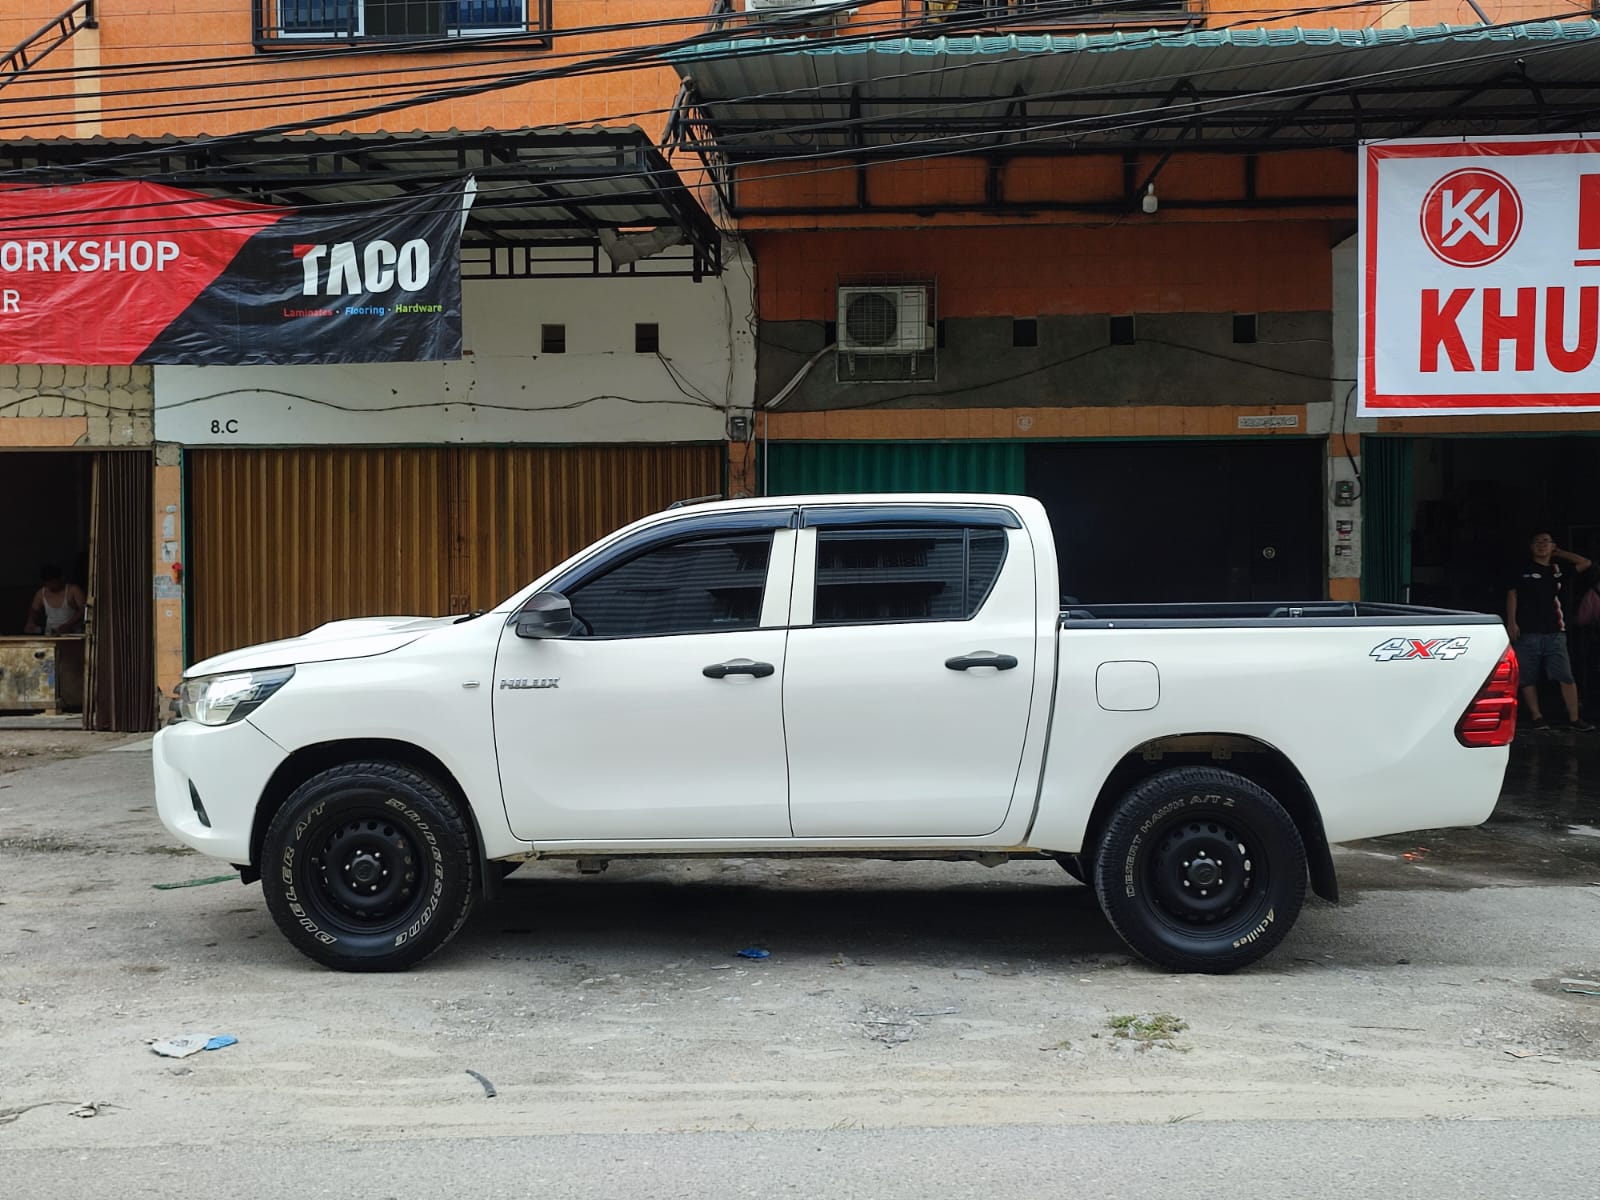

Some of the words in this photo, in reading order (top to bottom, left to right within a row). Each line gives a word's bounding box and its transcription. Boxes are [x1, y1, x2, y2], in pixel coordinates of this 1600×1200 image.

[0, 240, 180, 272] ORKSHOP
[293, 238, 430, 296] TACO
[3, 289, 20, 313] R
[283, 308, 333, 318] Laminates
[345, 305, 385, 317] Flooring
[395, 303, 443, 314] Hardware
[1420, 285, 1599, 373] KHU
[211, 419, 239, 434] 8.C
[500, 678, 560, 689] HILUX
[282, 846, 337, 945] DUELER
[1232, 908, 1275, 949] Achilles
